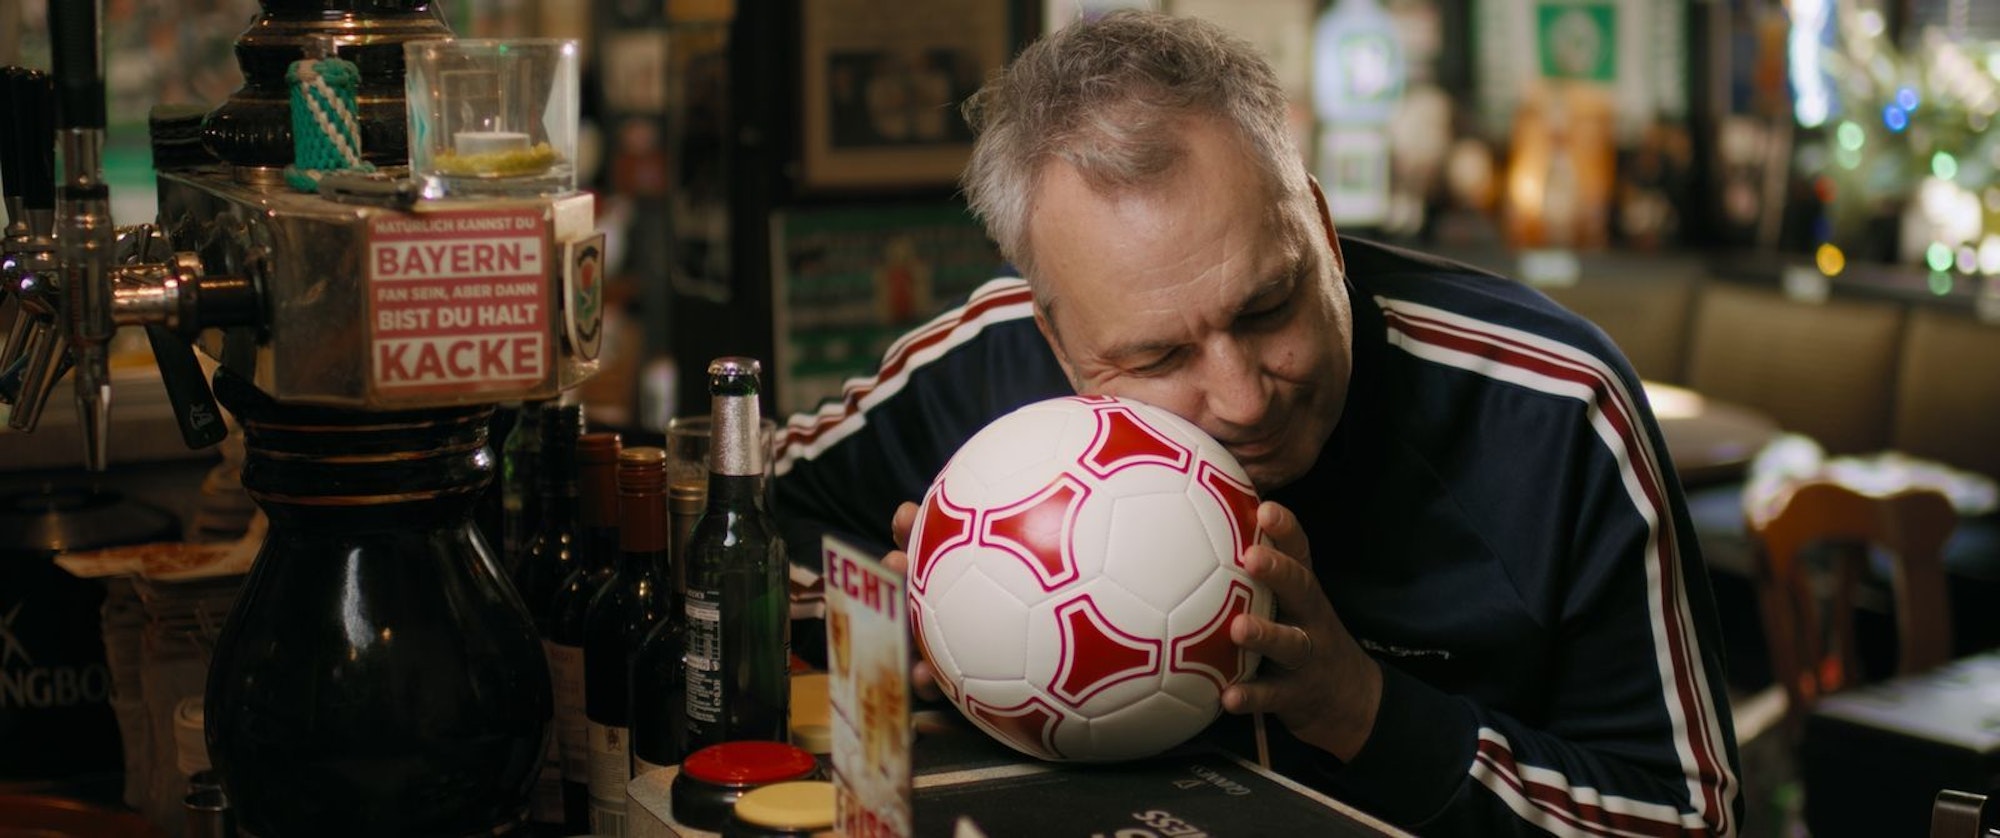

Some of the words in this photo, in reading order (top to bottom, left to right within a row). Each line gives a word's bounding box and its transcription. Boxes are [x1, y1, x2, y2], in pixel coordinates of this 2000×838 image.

[375, 217, 454, 234] NATÜRLICH
[456, 217, 512, 231] KANNST
[515, 216, 535, 230] DU
[378, 242, 536, 276] BAYERN-
[377, 288, 406, 301] FAN
[411, 286, 449, 301] SEIN,
[452, 284, 491, 299] ABER
[495, 283, 538, 297] DANN
[378, 308, 431, 331] BIST
[437, 306, 473, 328] DU
[478, 304, 539, 326] HALT
[380, 337, 538, 382] KACKE
[826, 549, 898, 622] ECHT
